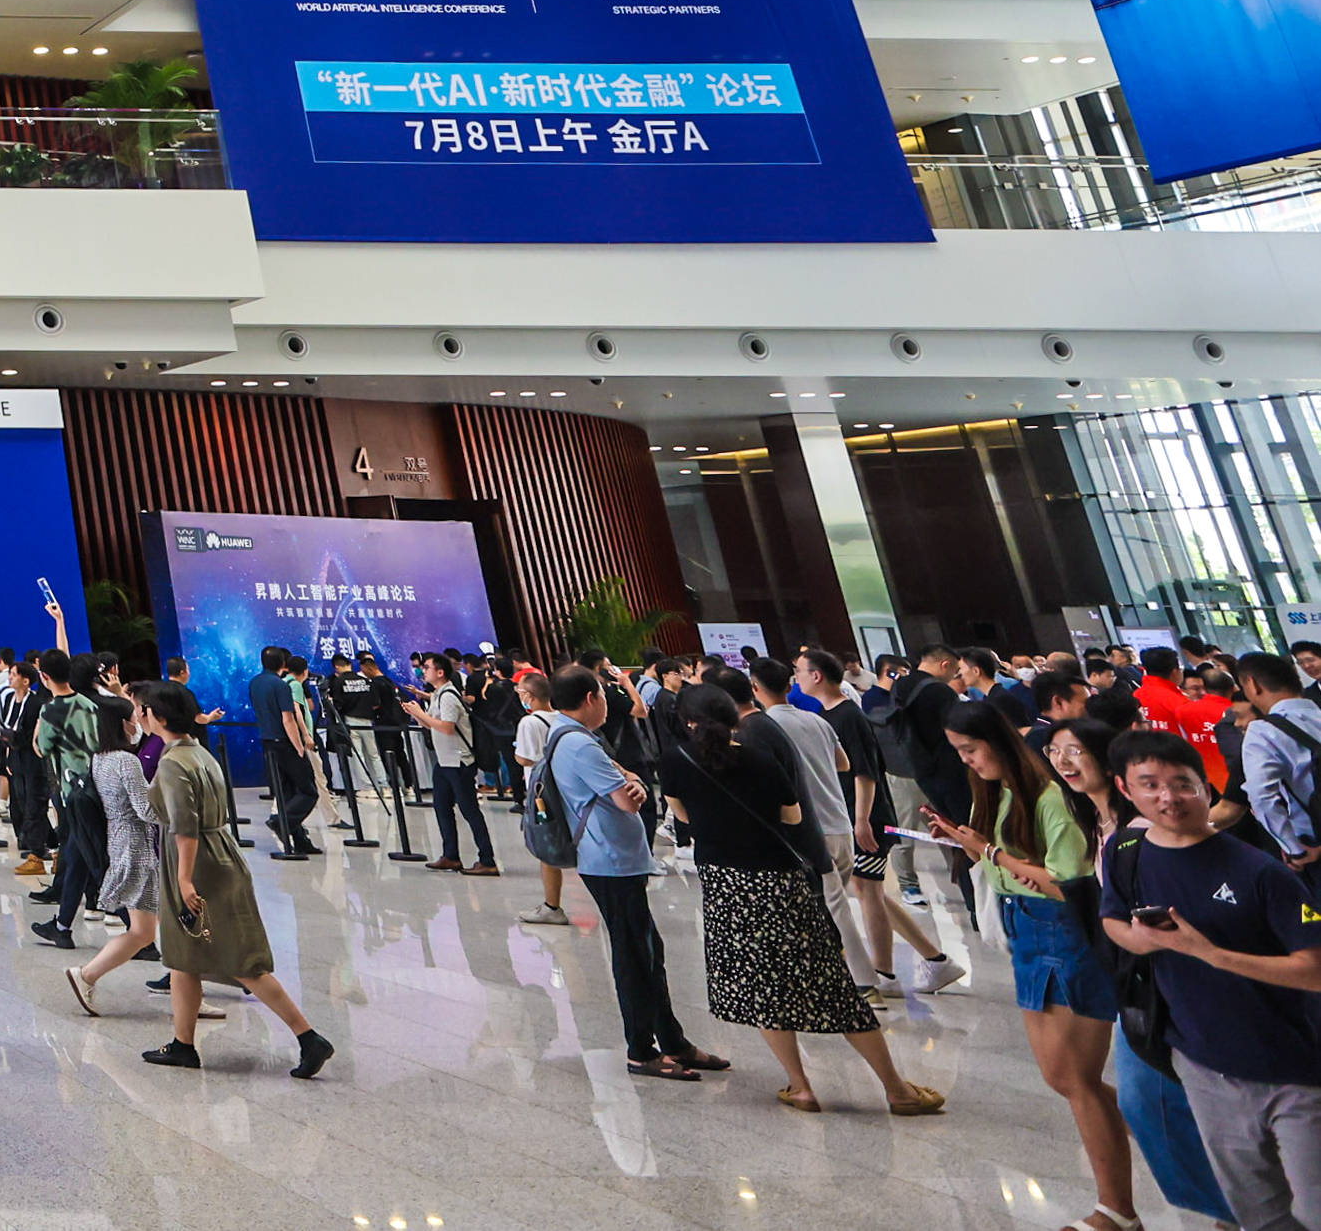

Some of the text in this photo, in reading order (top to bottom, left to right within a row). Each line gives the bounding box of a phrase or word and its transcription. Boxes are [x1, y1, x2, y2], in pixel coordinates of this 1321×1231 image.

[296, 3, 506, 14] WORLD ARTIFICIAL INTELLIGENCE CONFERENCE
[612, 5, 721, 15] STRATEGIC PARTNERS
[355, 447, 374, 480] 4
[220, 537, 252, 548] HUAWEI
